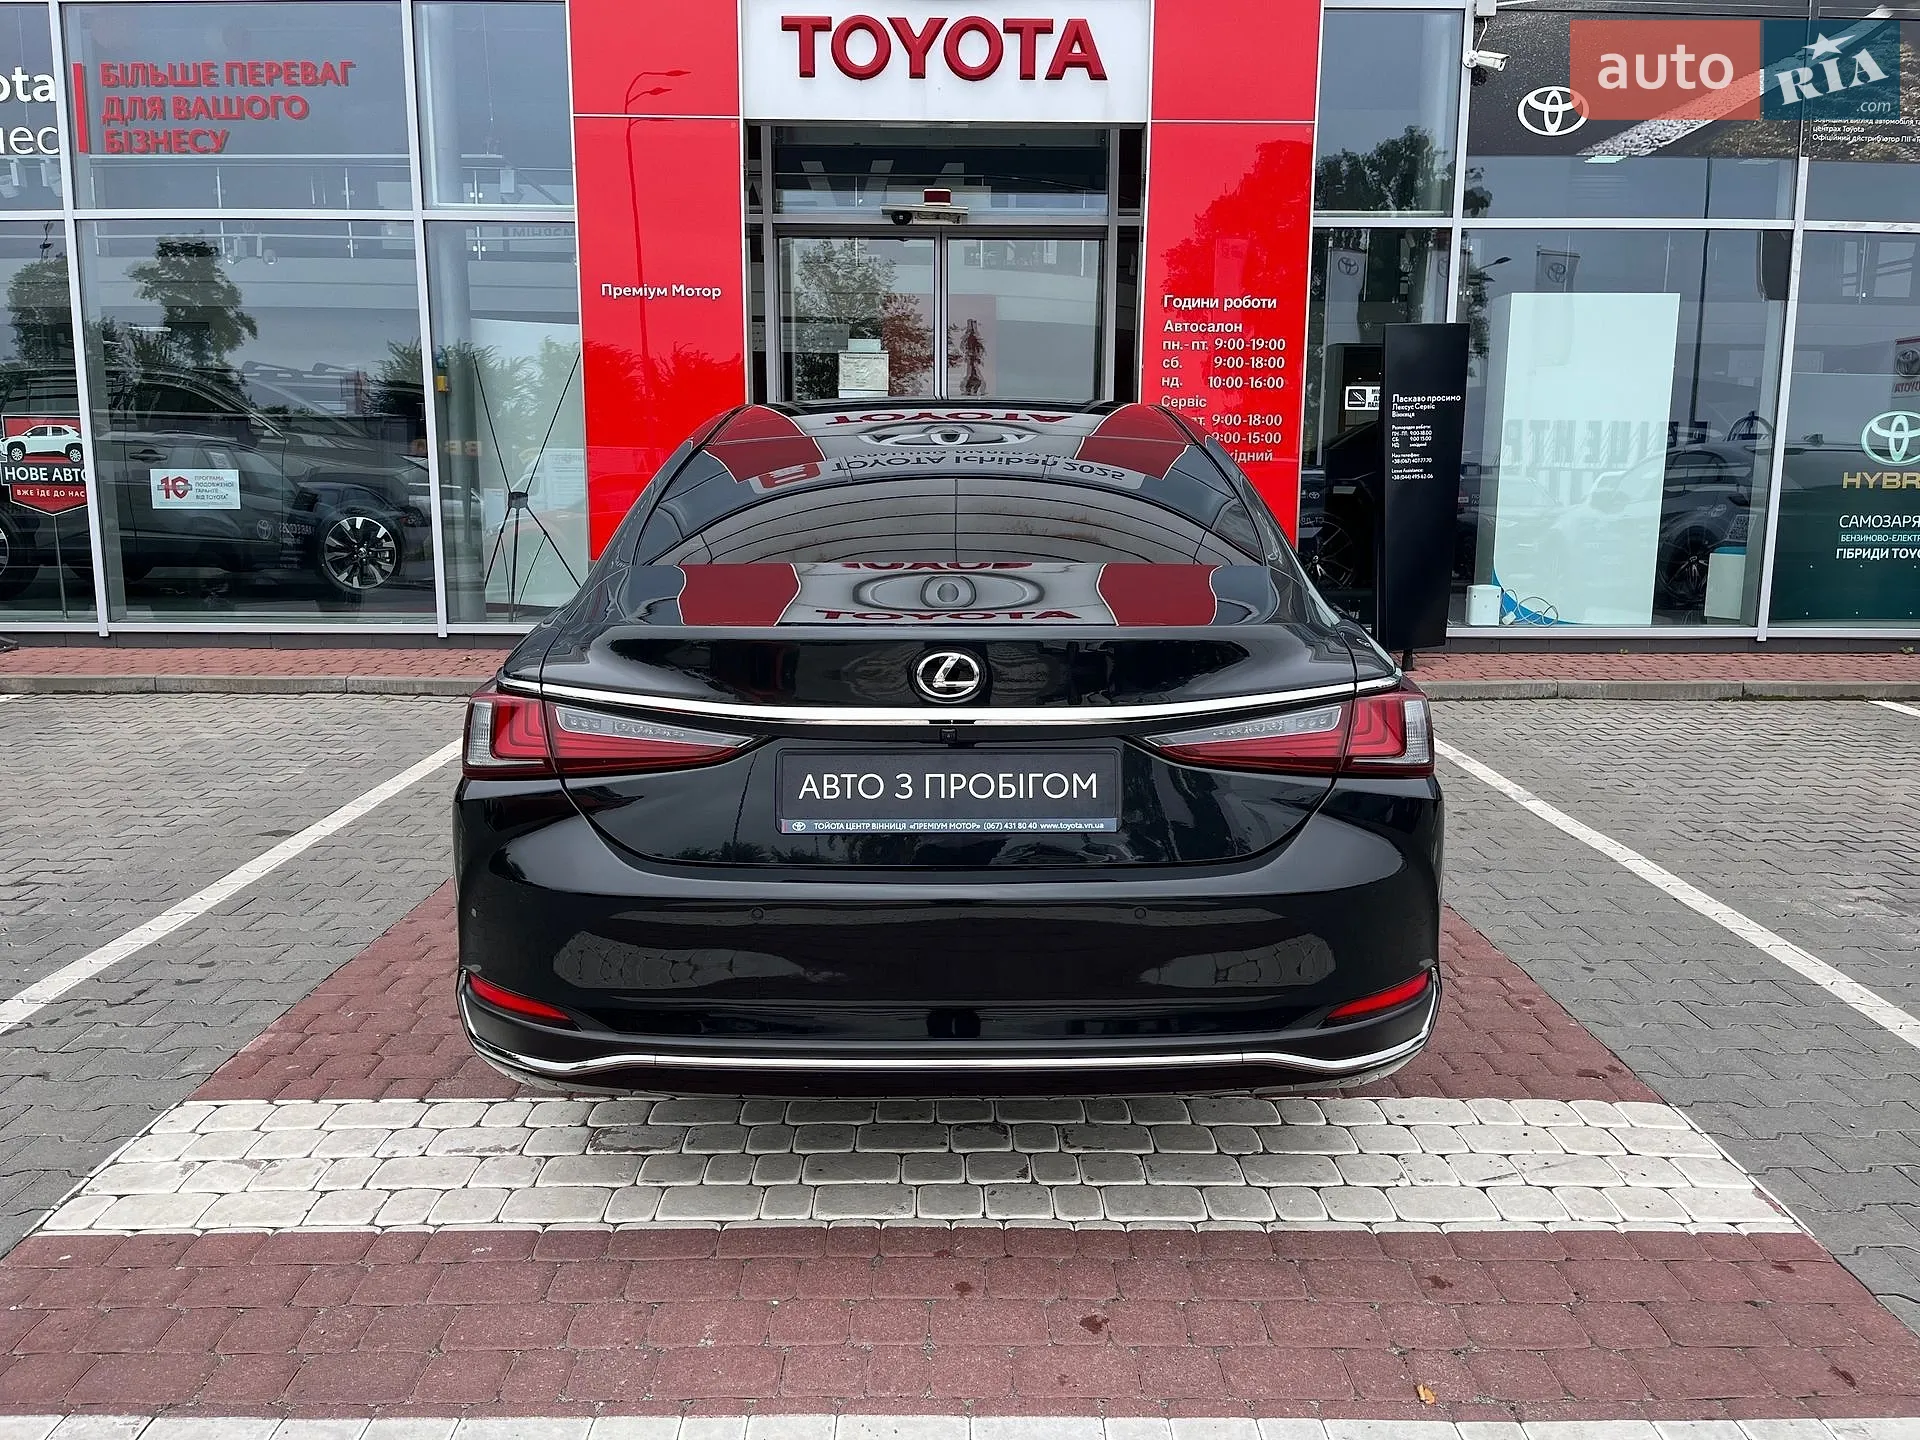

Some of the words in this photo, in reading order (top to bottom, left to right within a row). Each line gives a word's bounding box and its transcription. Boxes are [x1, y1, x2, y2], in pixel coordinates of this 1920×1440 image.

[781, 14, 1107, 81] TOYOTA
[100, 61, 219, 88] БІЛЬШЕ
[224, 60, 355, 87] ПЕРЕВАГ
[102, 95, 166, 126] ДЛЯ
[171, 94, 309, 121] ВАШОГО
[104, 128, 229, 154] БІЗНЕСУ
[601, 283, 668, 300] Преміум
[671, 284, 722, 300] Мотор
[1163, 294, 1219, 309] Години
[1223, 294, 1277, 311] роботи
[1163, 319, 1243, 333] Автосалон
[1214, 337, 1286, 351] 9:00-19:00
[1162, 355, 1183, 369] сб.
[1213, 356, 1285, 369] 9:00-18:00
[1161, 376, 1183, 388] нд.
[1207, 376, 1285, 389] 10:00-16:00
[1161, 395, 1207, 410] Сервіс
[1211, 414, 1283, 427] 9:00-18:00
[4, 466, 49, 482] НОВЕ
[53, 490, 66, 498] ДО
[68, 490, 86, 498] НАС
[1836, 548, 1890, 560] ГІБРИДИ
[798, 773, 885, 800] АВТО
[894, 773, 914, 800] З
[925, 772, 1098, 800] ПРОБІГОМ
[814, 821, 845, 830] ТОЙОТА
[845, 822, 871, 831] ЦЕНТР
[872, 822, 907, 831] ВІННИЦЯ
[909, 822, 947, 830] «ПРЕМІУМ
[949, 822, 981, 830] МОТОР»
[983, 822, 1003, 831] (067)
[1004, 822, 1016, 830] 431
[1017, 822, 1027, 830] 80
[1028, 822, 1038, 830] 40
[1039, 821, 1104, 831] www.toyota.vn.ua
